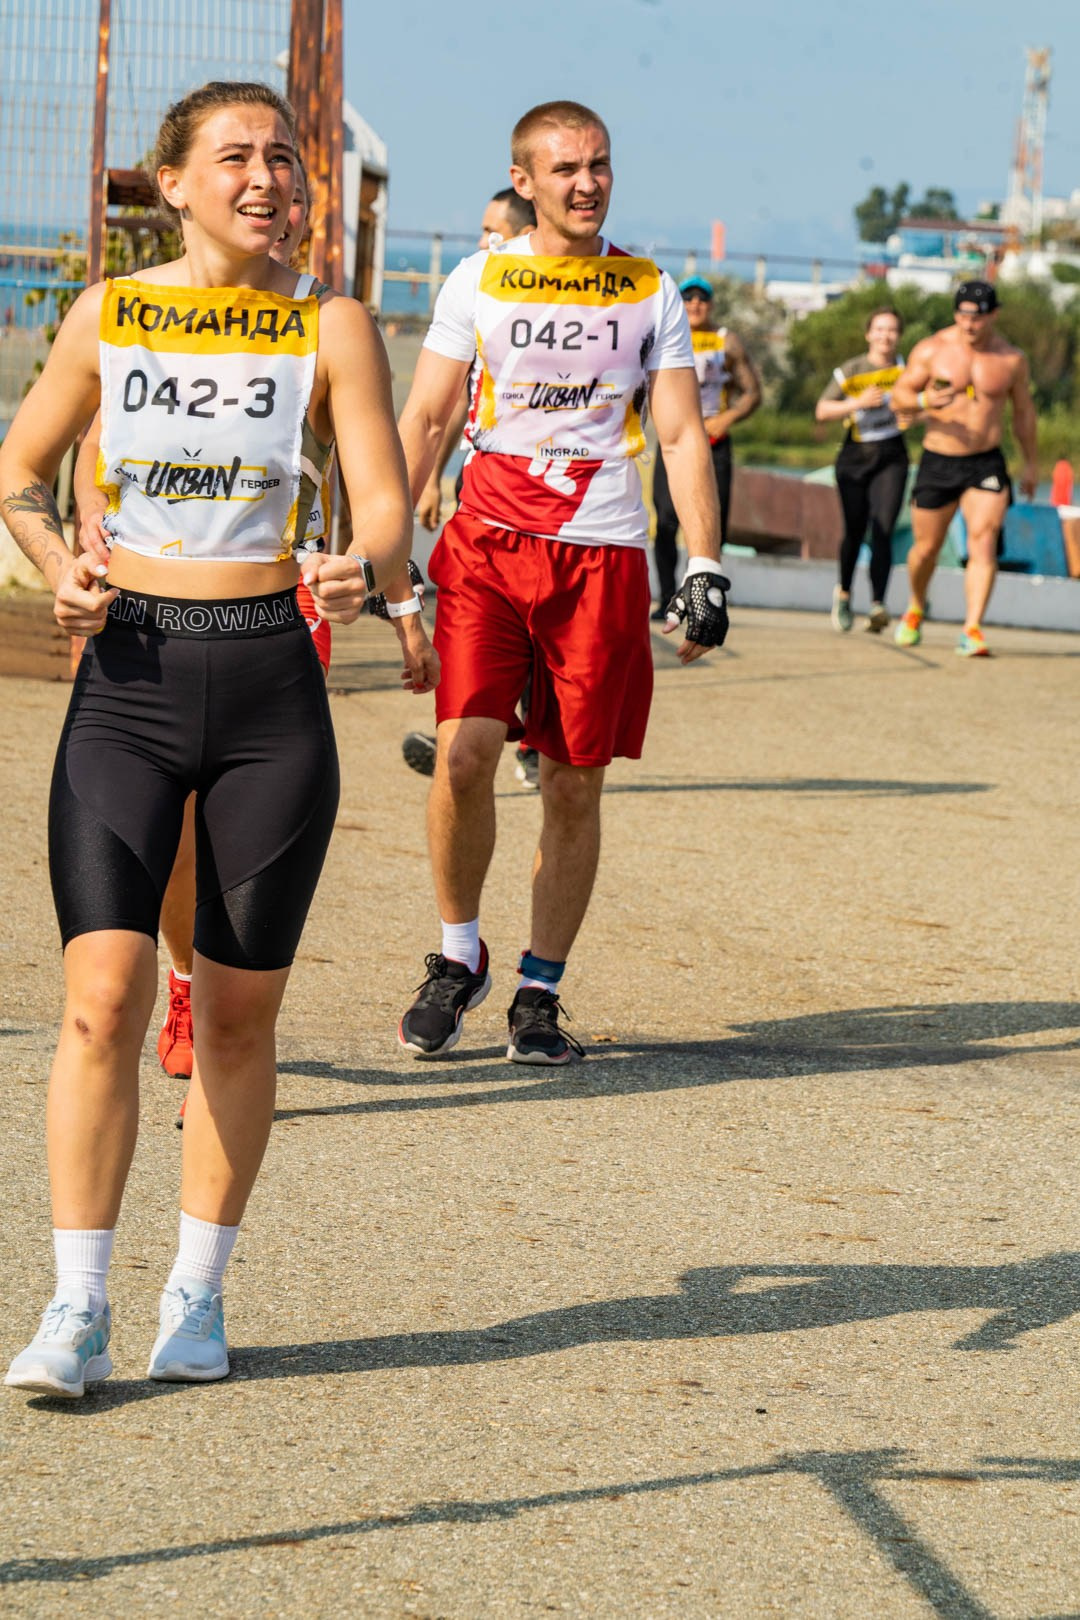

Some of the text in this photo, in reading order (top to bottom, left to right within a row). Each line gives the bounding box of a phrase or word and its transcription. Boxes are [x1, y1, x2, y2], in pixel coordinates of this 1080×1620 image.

[500, 268, 637, 298] КОМАНДА
[116, 296, 306, 342] КОМАНДА
[511, 319, 619, 350] 042-1
[123, 369, 276, 418] 042-3
[528, 378, 598, 409] URBAN
[540, 447, 589, 457] INGRAD
[145, 456, 242, 501] URBAN
[240, 478, 280, 490] ГЕРОЕВ
[156, 596, 295, 632] ROWAN
